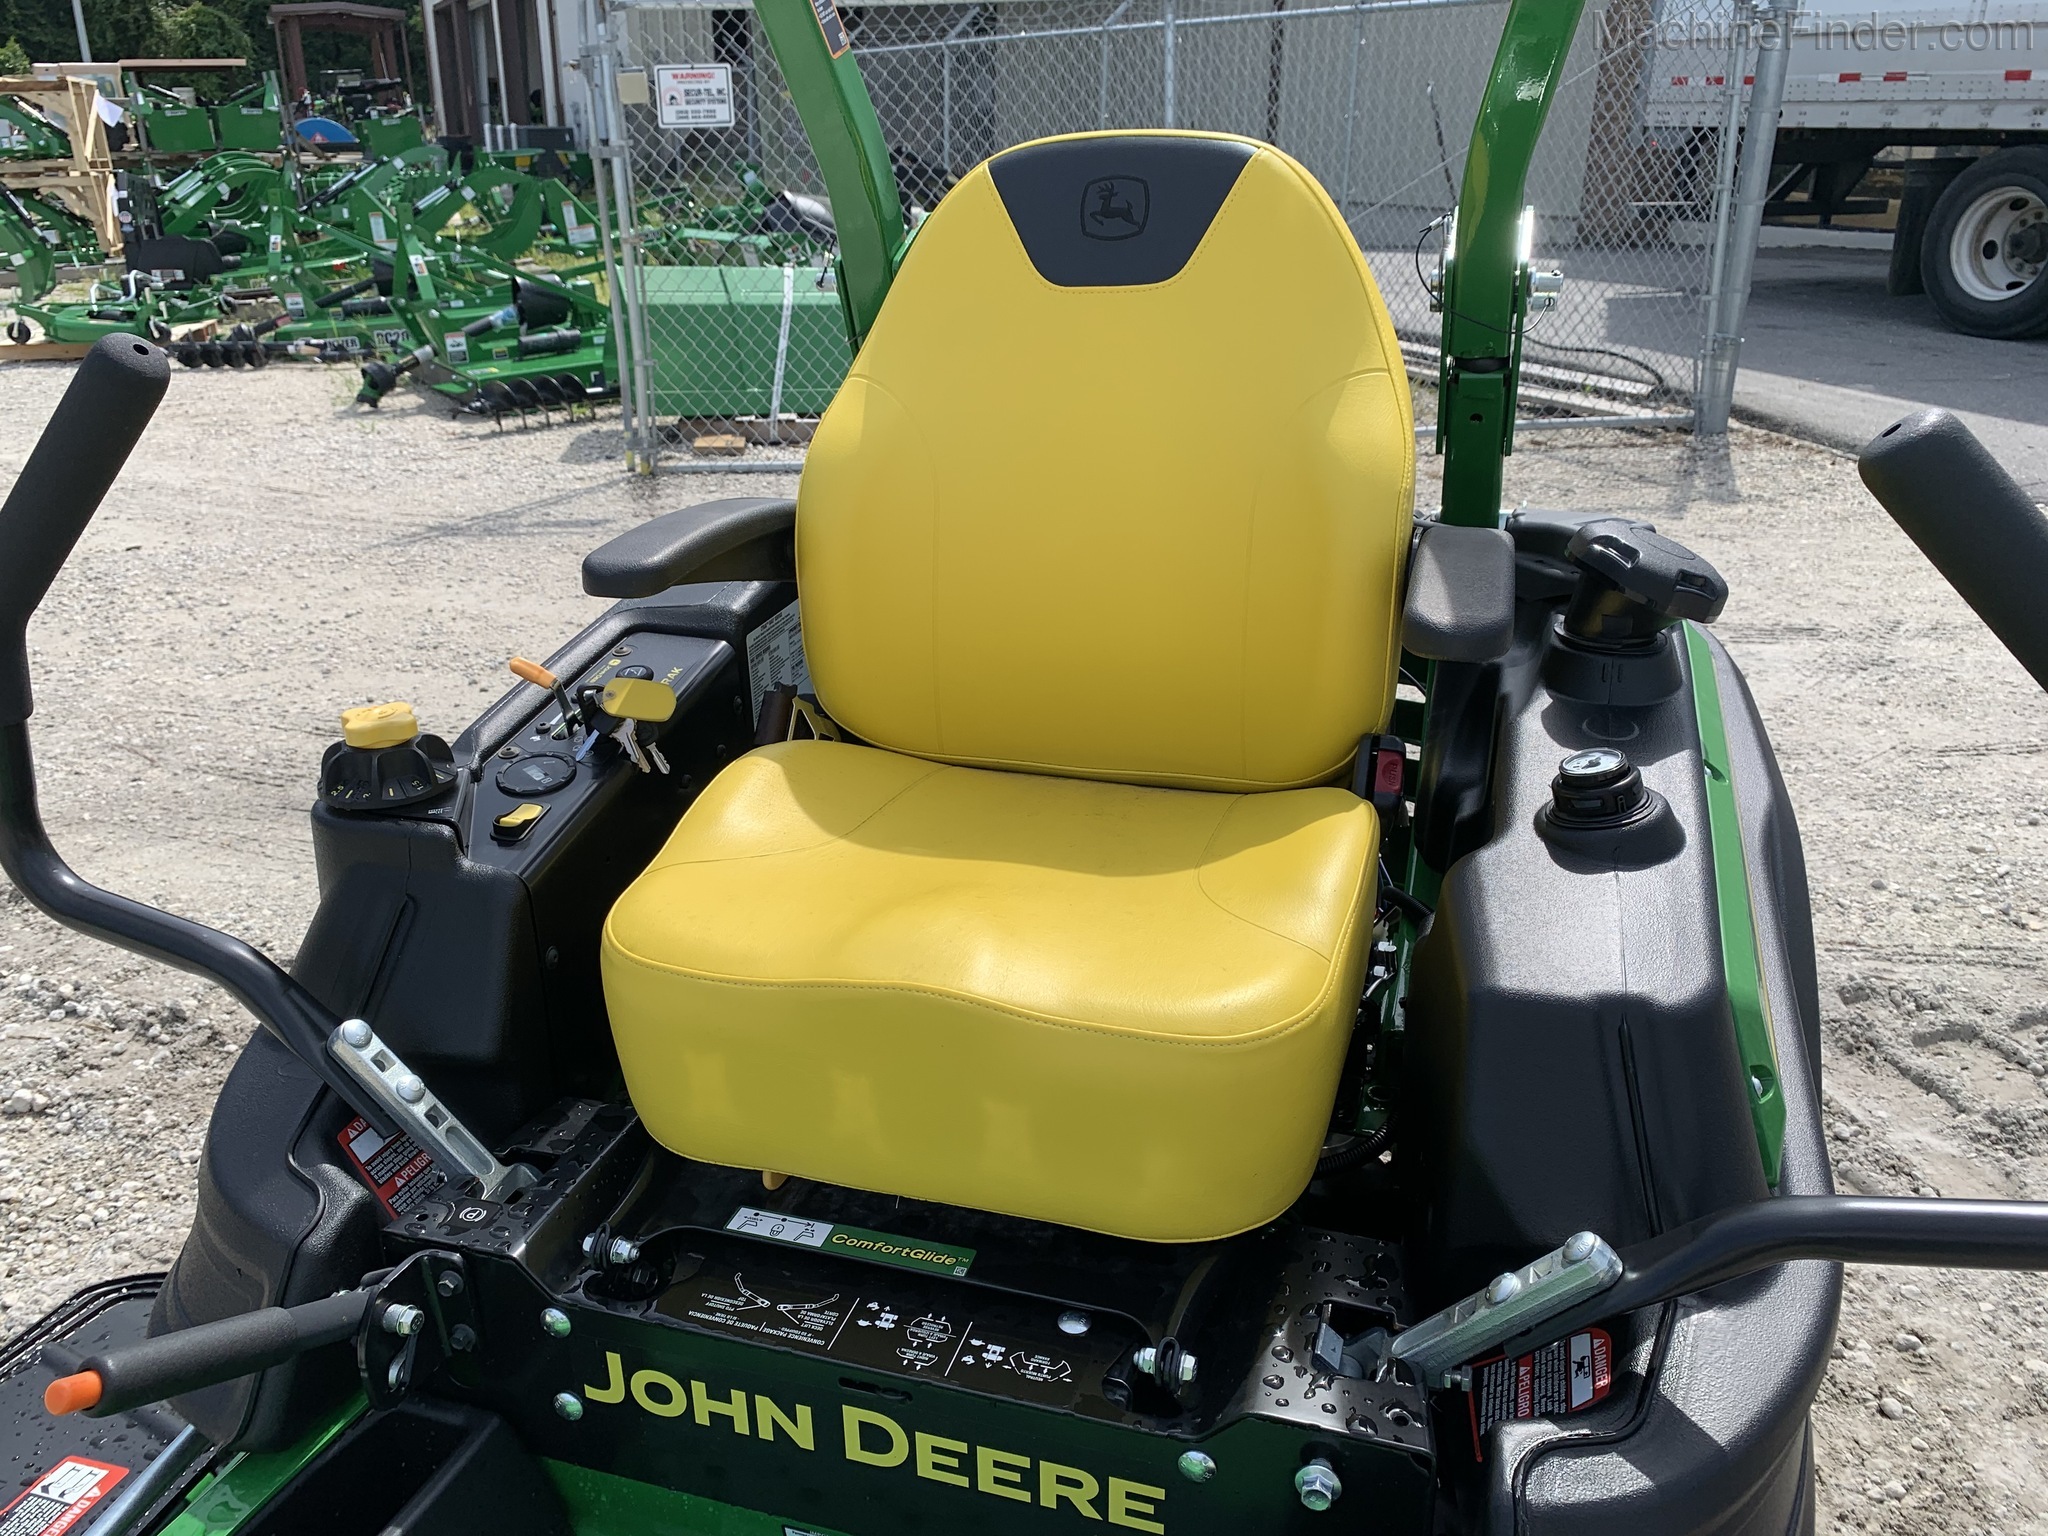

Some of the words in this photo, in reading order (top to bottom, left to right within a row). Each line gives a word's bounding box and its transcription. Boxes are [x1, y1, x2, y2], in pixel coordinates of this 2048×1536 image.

[661, 667, 683, 685] RAK
[400, 1151, 431, 1181] PELIGR
[688, 1310, 726, 1323] CONVENIENCIA
[734, 1320, 758, 1330] PAQUETE
[762, 1327, 787, 1336] PACKAGE
[787, 1332, 824, 1345] CONVENIENCE
[1594, 1347, 1609, 1390] DANGER
[1517, 1375, 1530, 1418] PELIGRO
[583, 1350, 815, 1451] JOHN
[841, 1404, 1166, 1535] DEERE
